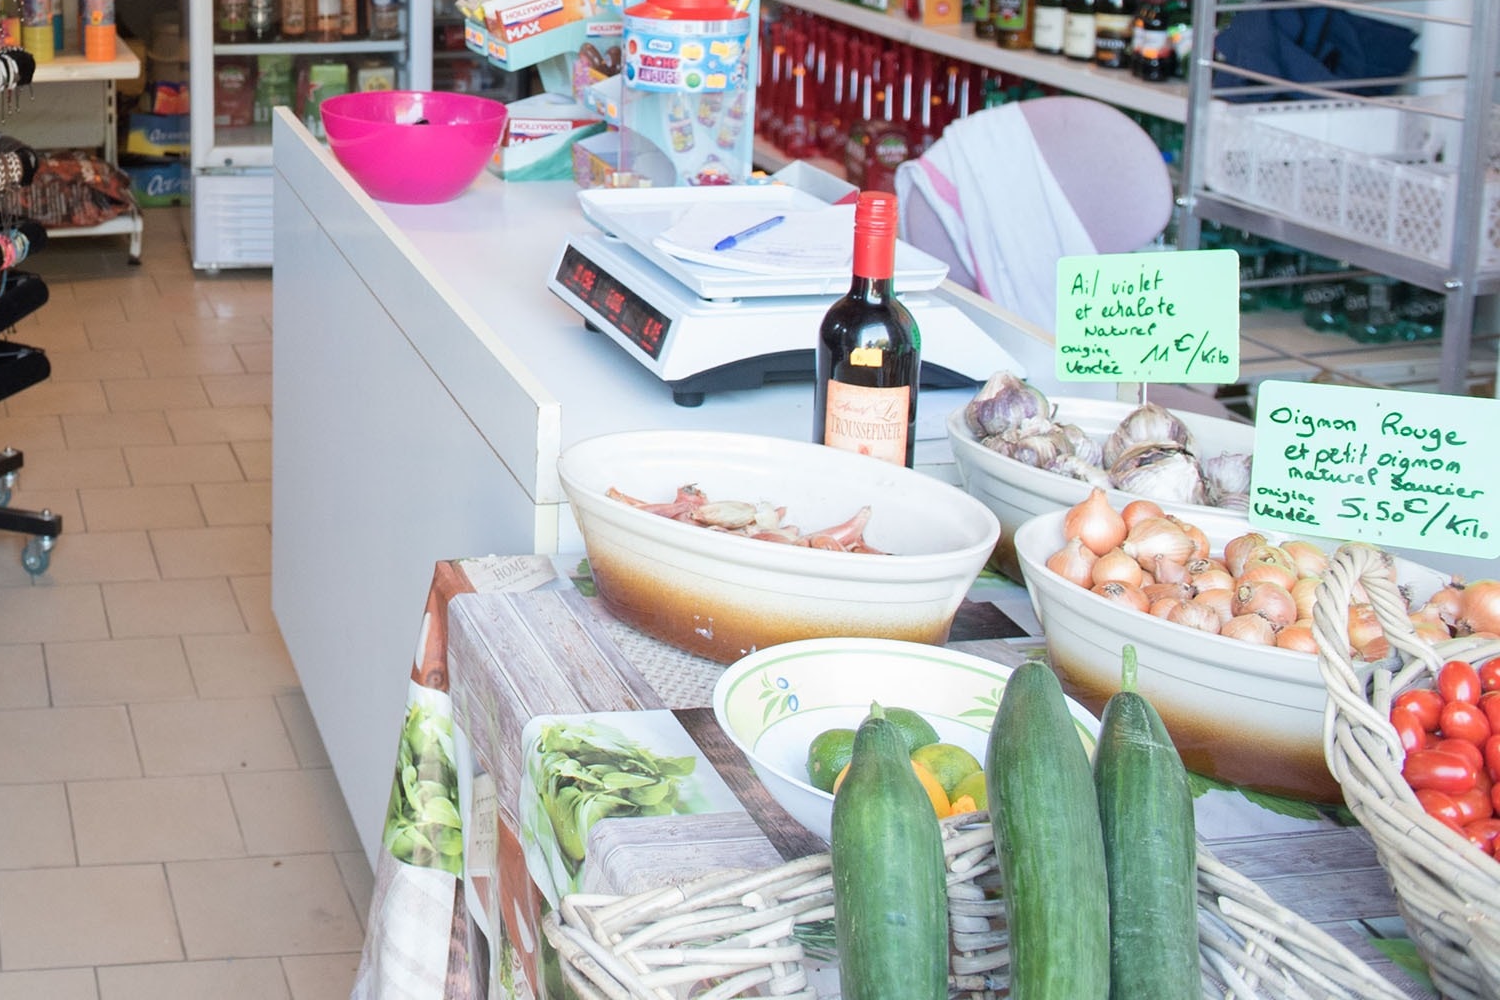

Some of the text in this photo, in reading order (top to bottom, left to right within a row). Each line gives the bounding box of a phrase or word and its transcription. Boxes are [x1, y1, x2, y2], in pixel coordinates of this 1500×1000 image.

[505, 20, 542, 42] MAX
[513, 122, 572, 131] HOLLYWOOD
[1071, 269, 1164, 297] Ail violet
[1075, 303, 1093, 321] et
[1380, 411, 1468, 453] Rouge
[1283, 442, 1310, 461] et
[1314, 442, 1368, 471] petit
[492, 557, 529, 582] HOME
